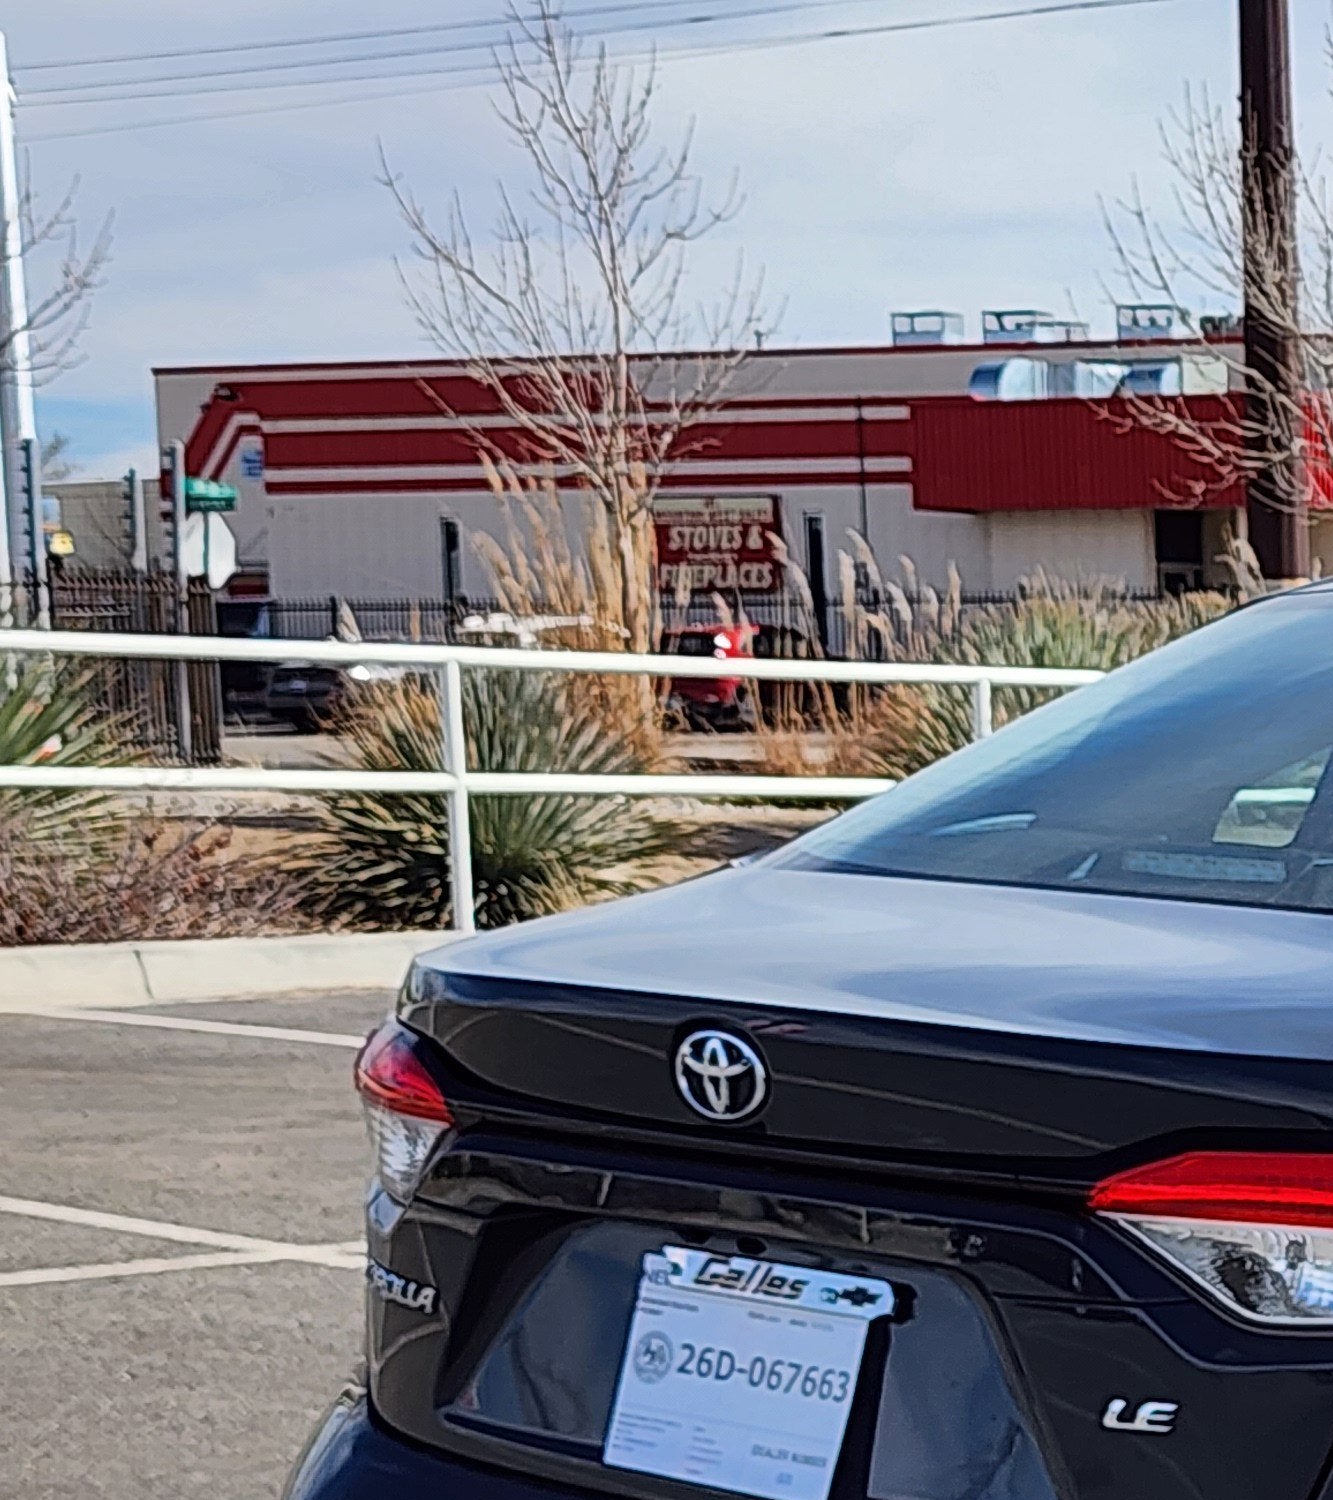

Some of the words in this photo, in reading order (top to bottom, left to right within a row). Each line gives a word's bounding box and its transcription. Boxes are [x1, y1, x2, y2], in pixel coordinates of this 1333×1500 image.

[668, 524, 744, 551] STOVES
[677, 1342, 851, 1403] 26D-067663
[1102, 1398, 1179, 1433] LE
